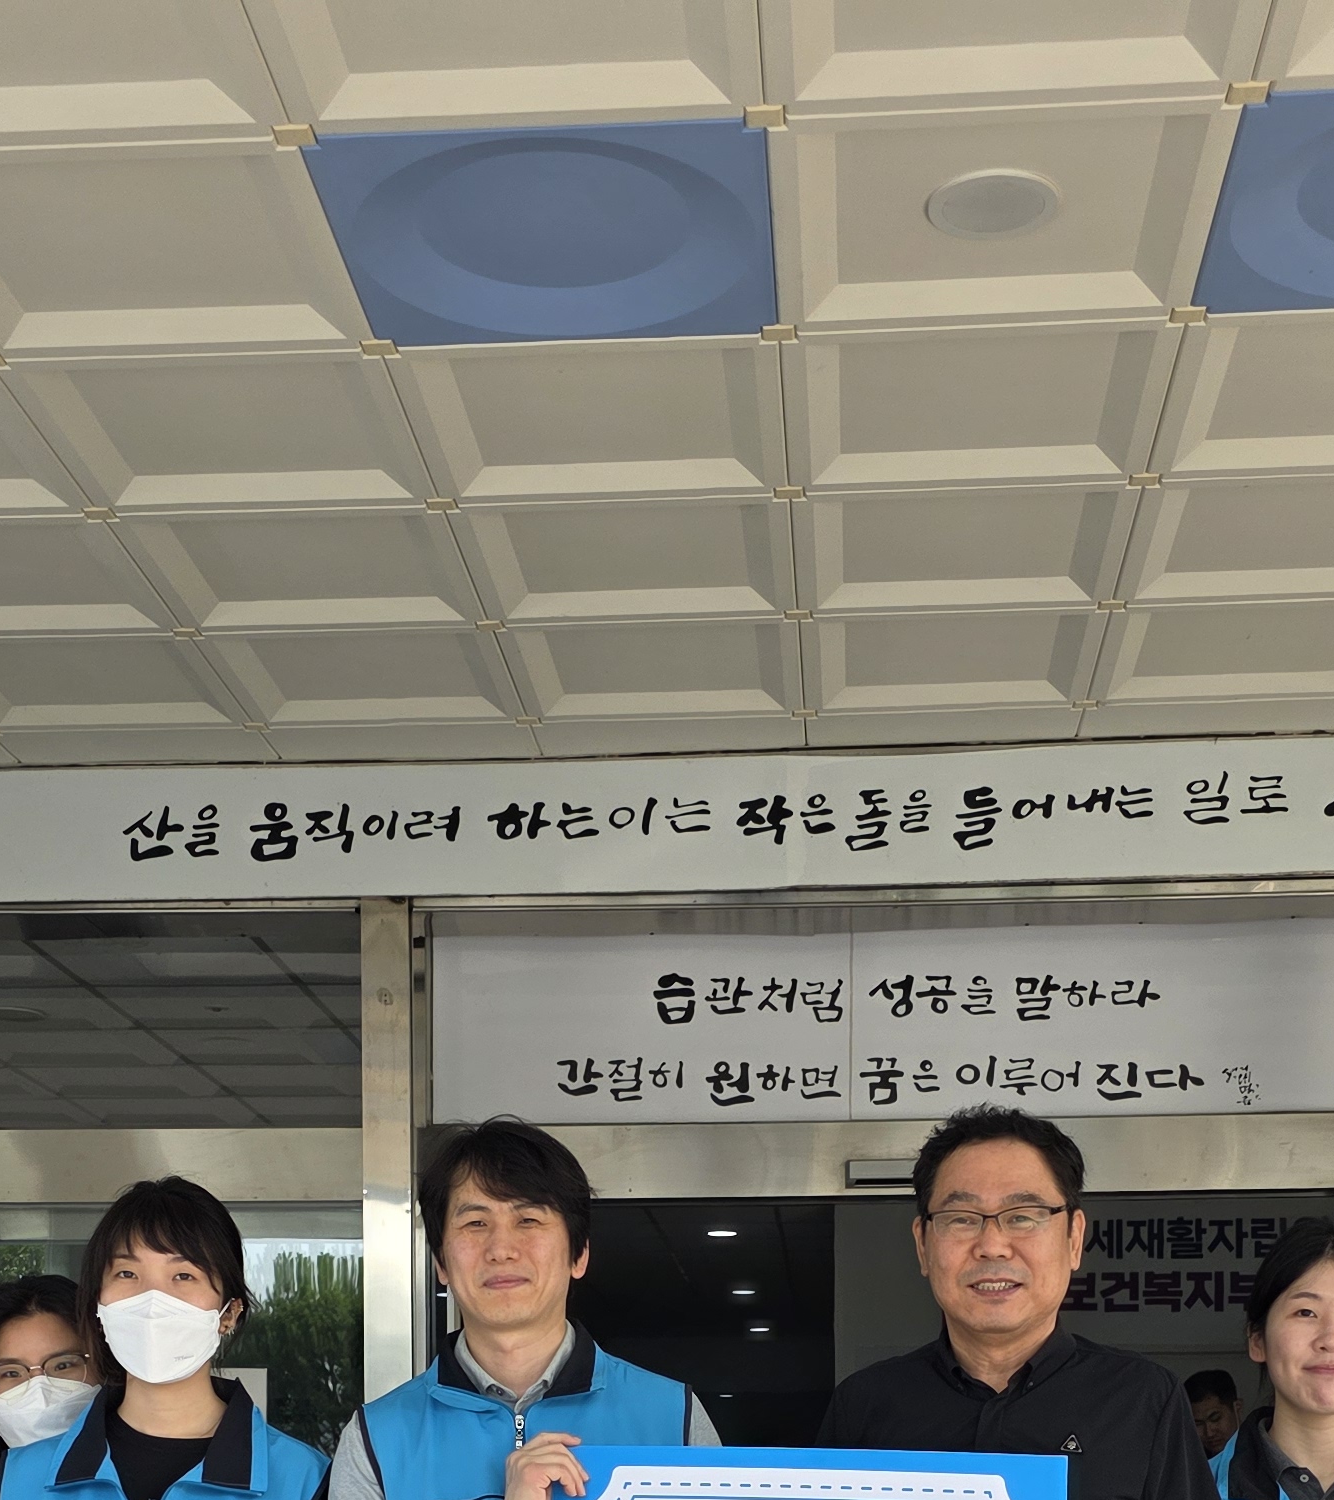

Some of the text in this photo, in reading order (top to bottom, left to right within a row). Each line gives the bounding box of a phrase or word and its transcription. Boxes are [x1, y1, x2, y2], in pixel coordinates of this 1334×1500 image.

[122, 804, 220, 862] 산을
[249, 802, 461, 862] 움직이려
[952, 786, 1154, 851] 들어내는
[1183, 770, 1289, 825] 일로
[652, 972, 1161, 1025] 습관처럼 성공을 말하라
[556, 1056, 684, 1102] 간절히
[705, 1061, 842, 1107] 원하면
[1085, 1216, 1303, 1260] 세재활자립
